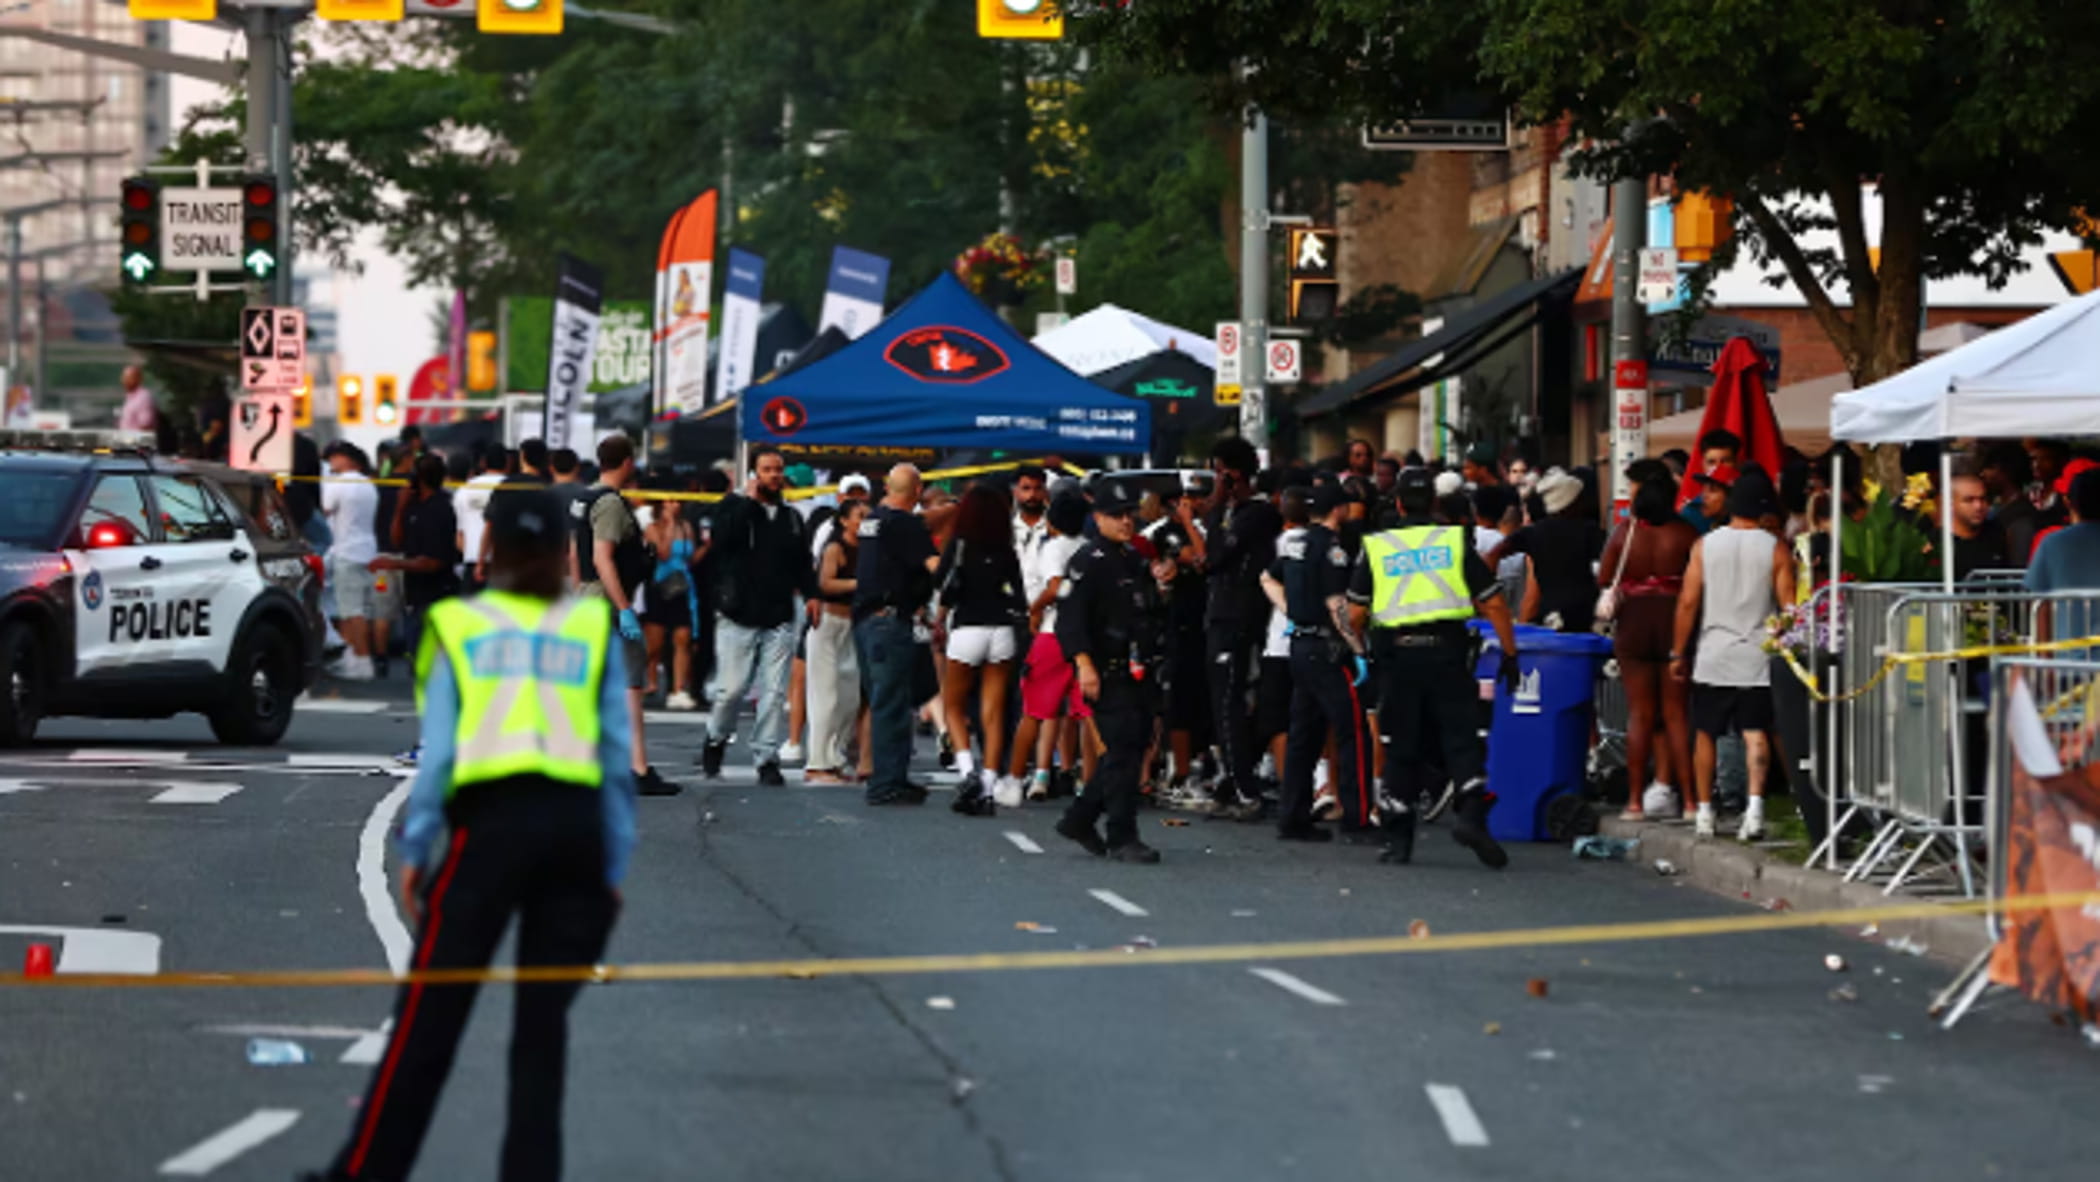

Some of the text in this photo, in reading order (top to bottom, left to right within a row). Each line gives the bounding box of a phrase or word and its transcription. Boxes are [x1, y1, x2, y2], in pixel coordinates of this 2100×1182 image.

[167, 202, 240, 224] TRANSIT
[173, 233, 235, 256] SIGNAL
[1385, 547, 1448, 573] POLICE
[109, 598, 211, 643] POLICE
